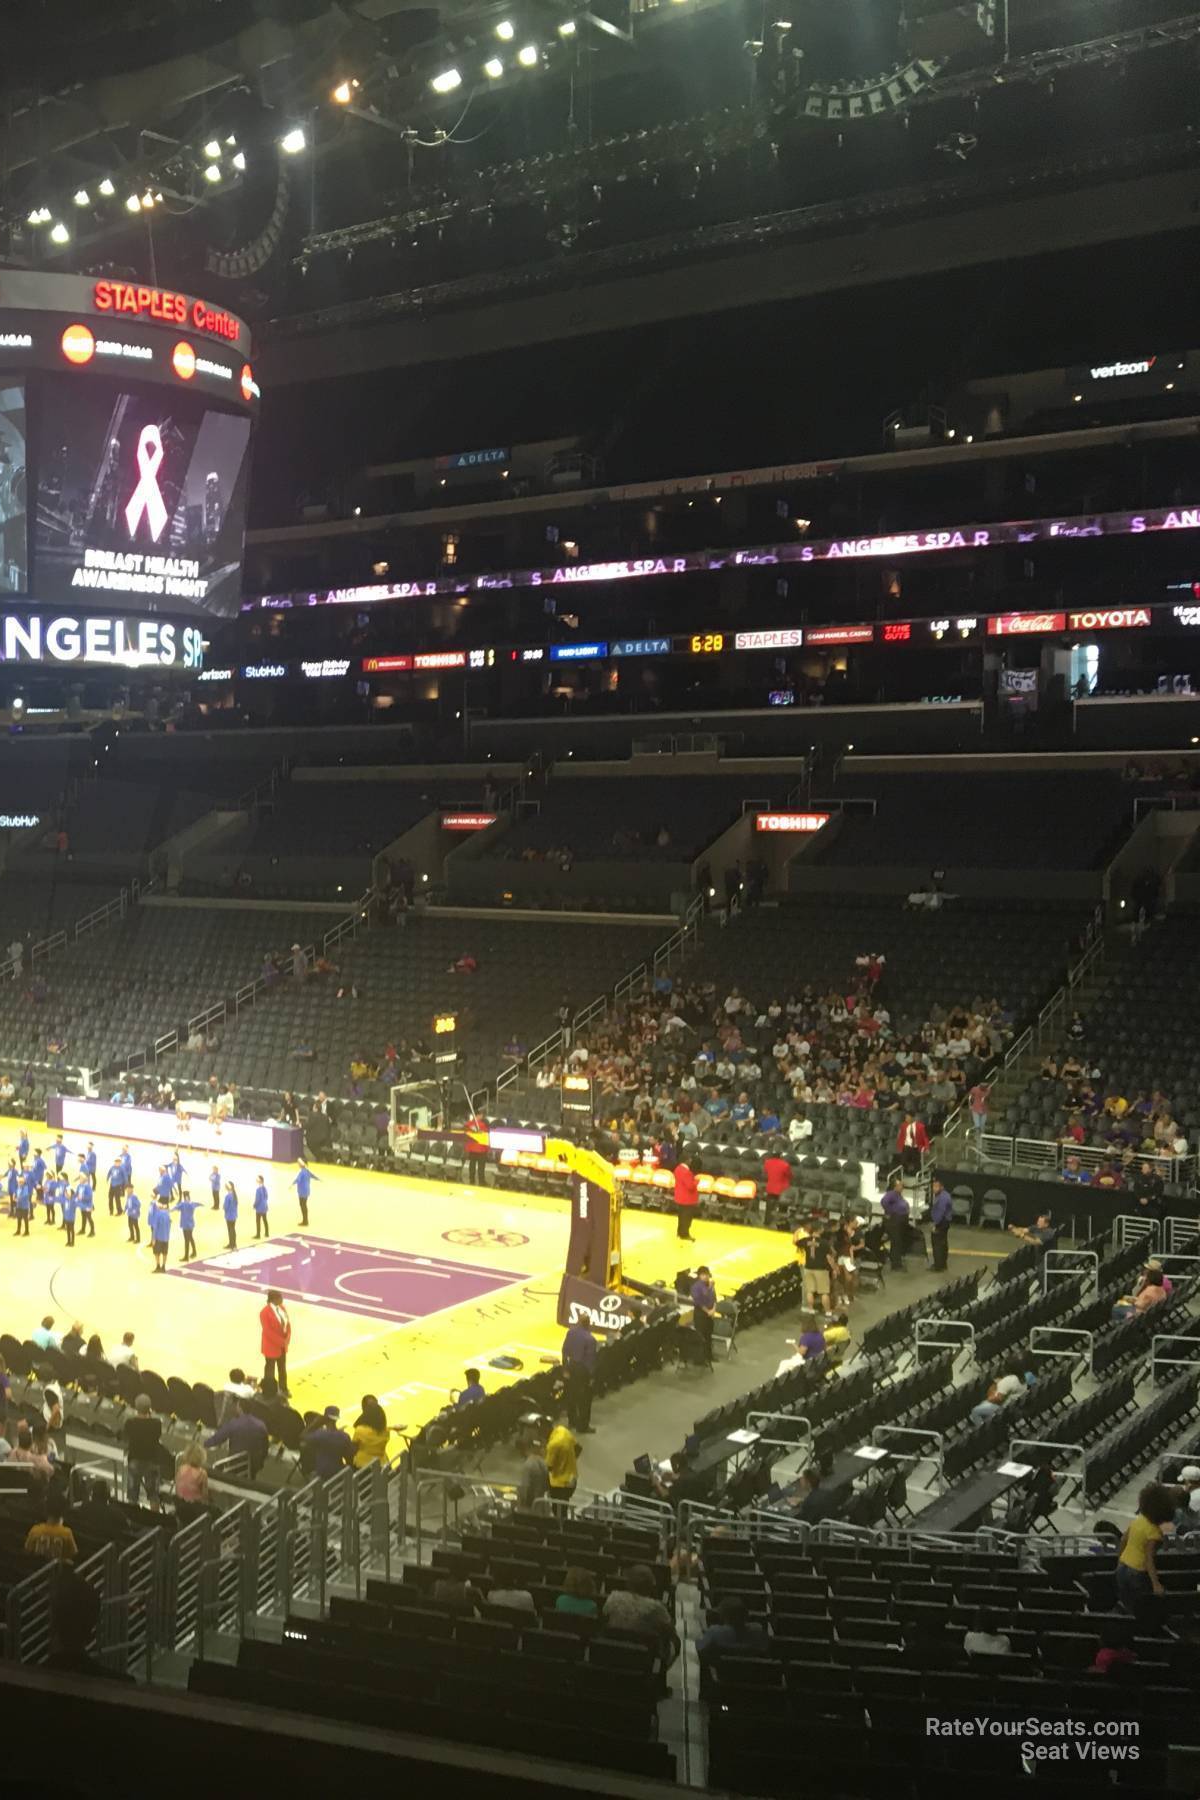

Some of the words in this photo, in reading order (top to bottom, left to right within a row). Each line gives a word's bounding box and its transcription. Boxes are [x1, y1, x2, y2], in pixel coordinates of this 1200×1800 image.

[96, 281, 188, 322] STAPLES
[193, 302, 240, 340] Center
[468, 451, 505, 464] DELTA
[145, 556, 199, 579] HEALTH
[1069, 609, 1150, 629] TOYOTA
[625, 641, 669, 654] DELTA
[692, 634, 723, 653] 6:28
[737, 631, 800, 648] STAPLES
[414, 653, 465, 668] TOSHIBA
[245, 665, 284, 677] StubHub
[0, 815, 40, 827] StubHub
[568, 1302, 632, 1329] SPALDI
